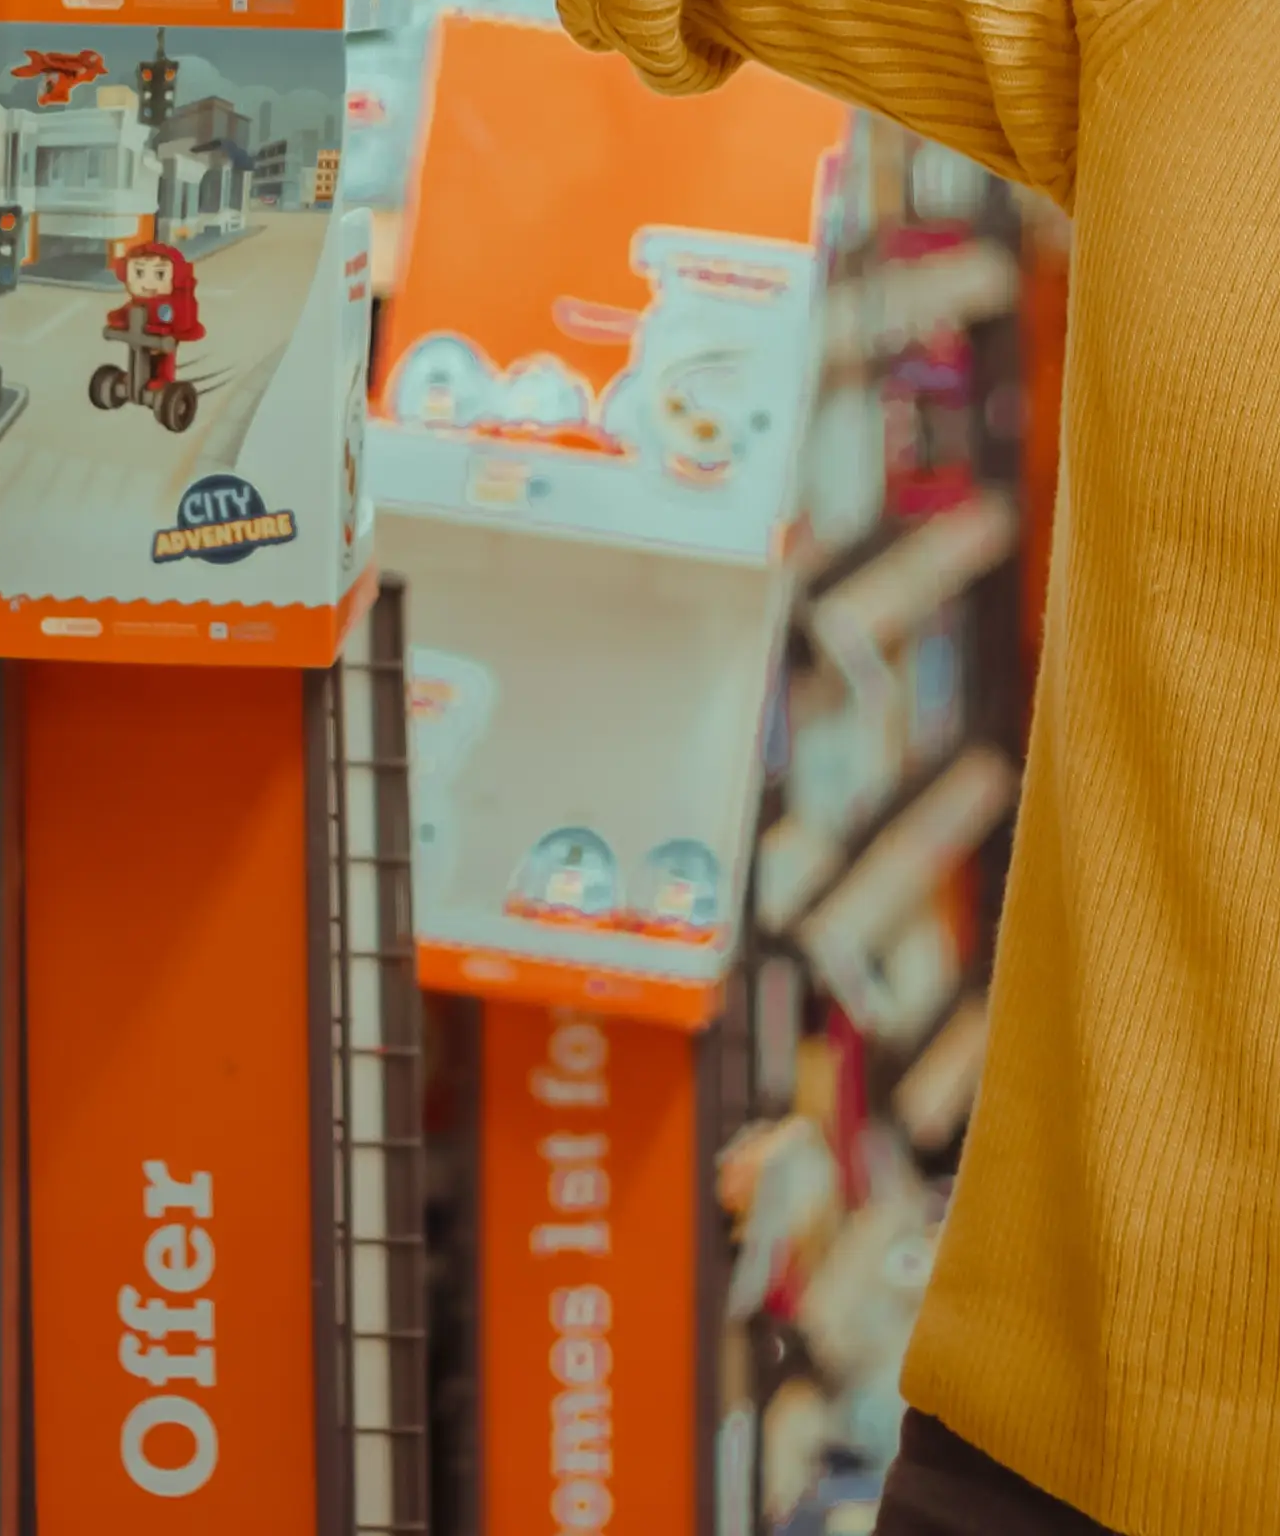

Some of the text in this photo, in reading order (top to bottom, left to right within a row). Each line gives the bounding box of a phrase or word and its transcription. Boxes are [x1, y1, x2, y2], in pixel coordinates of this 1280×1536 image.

[153, 513, 294, 558] ADVENTURE
[183, 485, 252, 525] CITY
[527, 1005, 611, 1107] fo
[117, 1160, 219, 1498] Offer
[548, 1283, 614, 1536] omes
